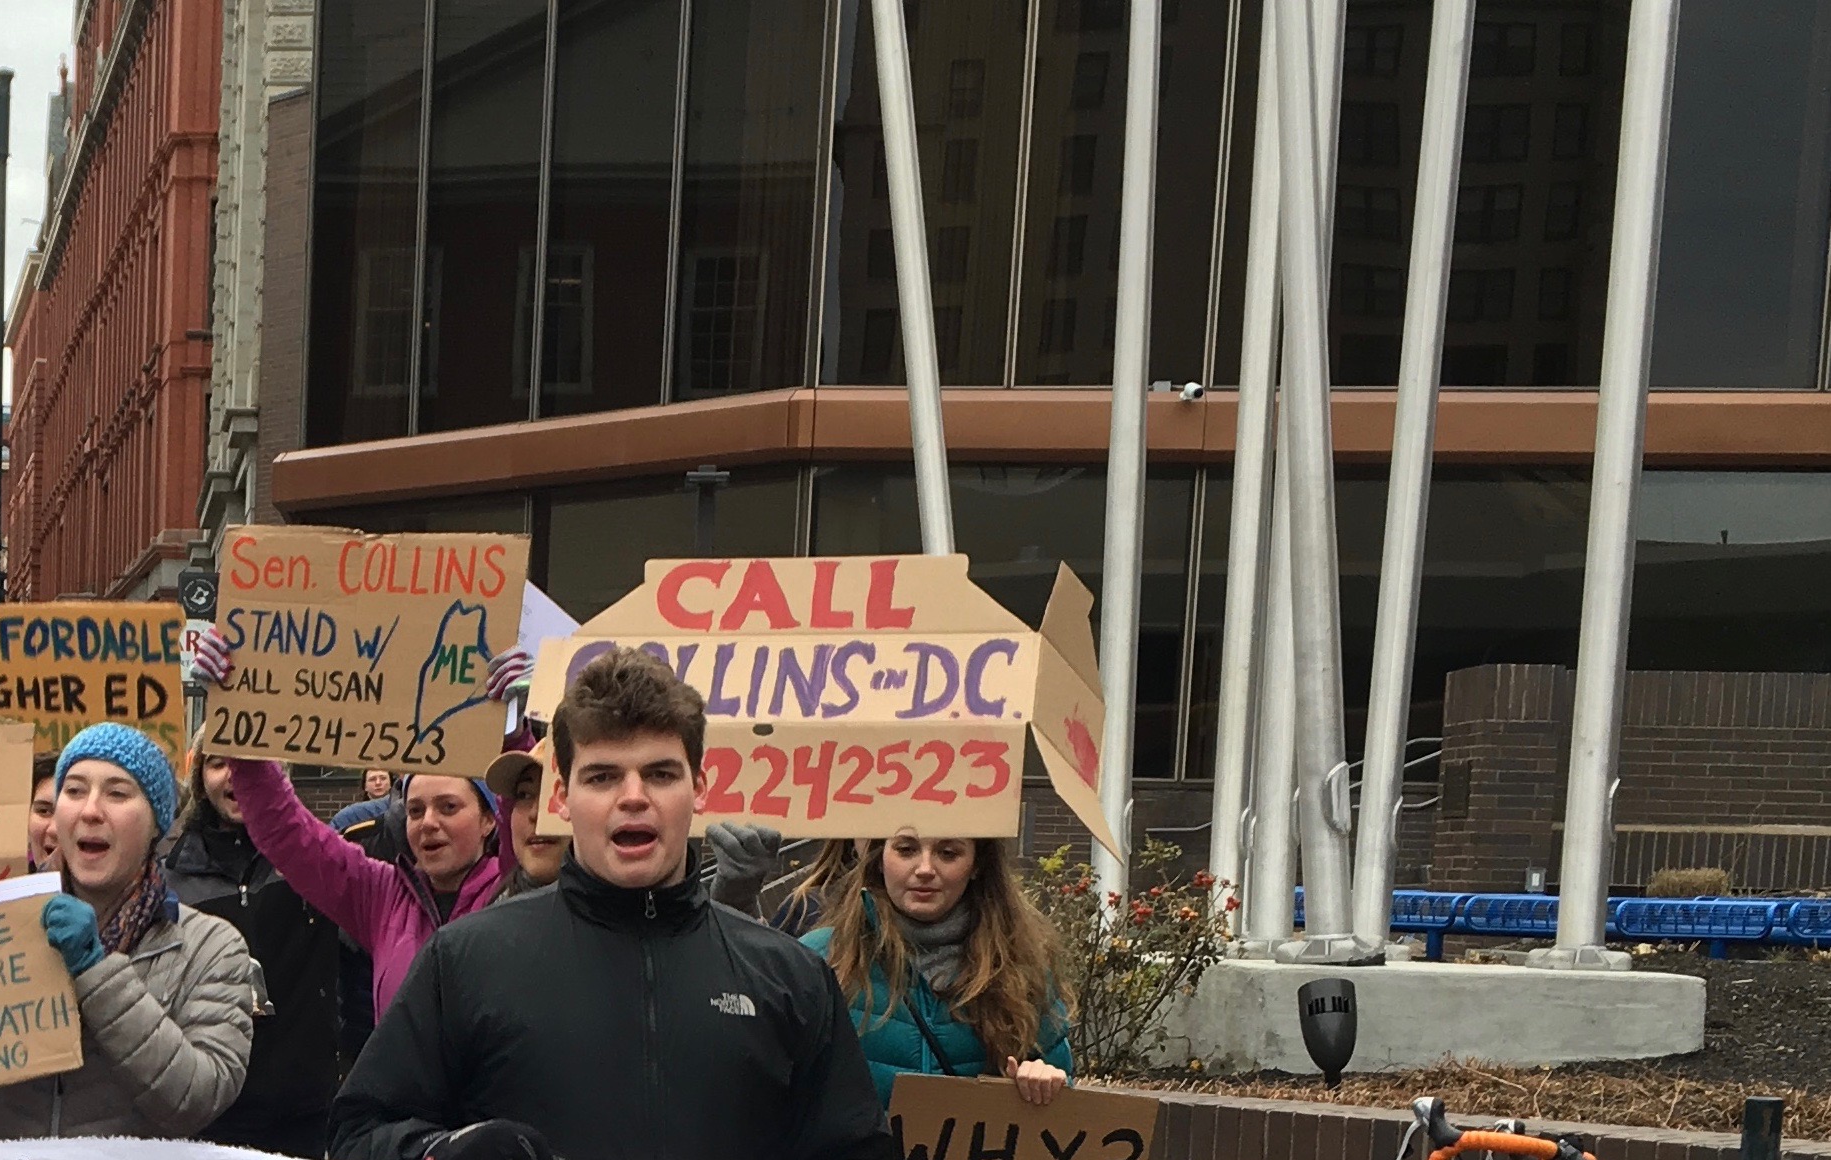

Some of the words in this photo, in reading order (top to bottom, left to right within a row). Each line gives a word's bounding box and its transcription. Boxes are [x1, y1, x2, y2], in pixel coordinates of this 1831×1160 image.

[230, 536, 317, 590] Sen.
[338, 540, 506, 598] COLLINS
[656, 559, 915, 632] CALL
[222, 606, 336, 657] STAND
[217, 665, 281, 695] CALL
[294, 668, 384, 702] SUSAN
[431, 644, 479, 686] ME
[895, 639, 1022, 719] D.C.
[104, 672, 168, 720] ED
[211, 706, 446, 766] 202-224-2523
